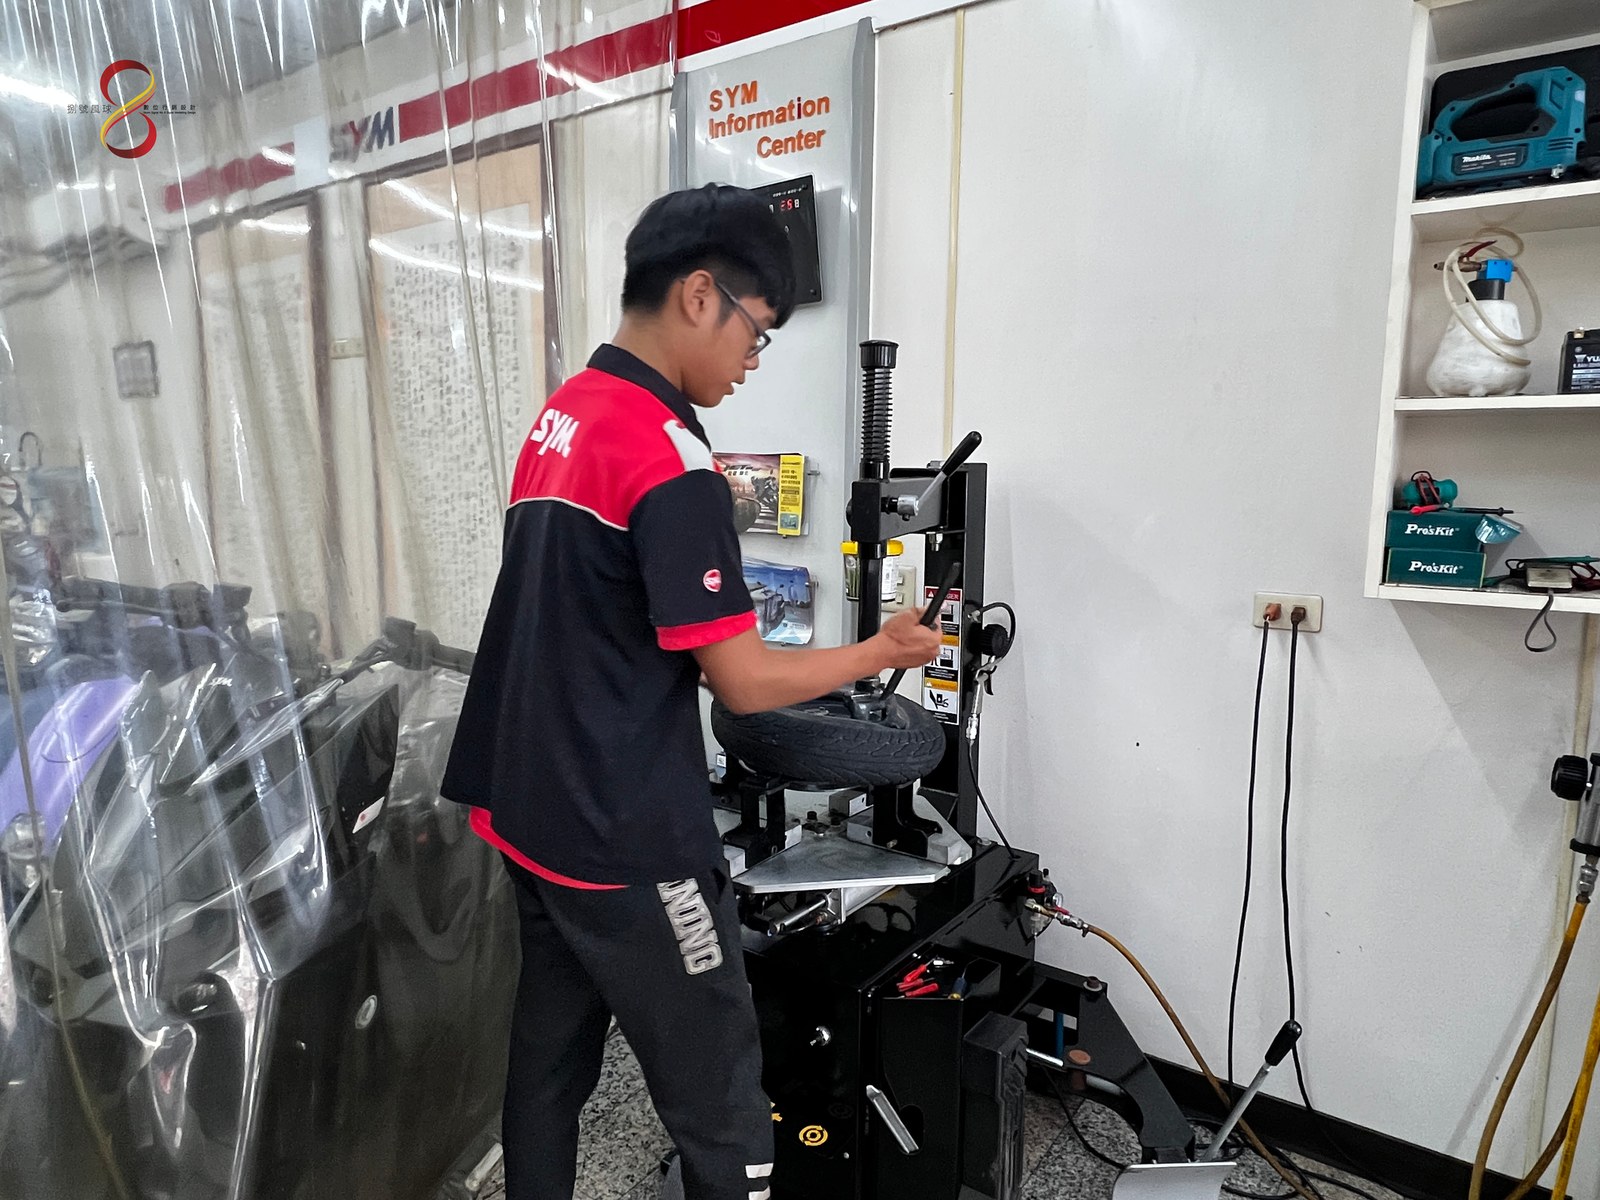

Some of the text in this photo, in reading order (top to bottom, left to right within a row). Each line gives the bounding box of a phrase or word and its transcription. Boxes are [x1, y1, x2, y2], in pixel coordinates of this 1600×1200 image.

[708, 96, 831, 139] Information
[709, 80, 758, 112] SYM
[756, 129, 826, 159] Center
[530, 408, 580, 458] SYM
[656, 877, 724, 976] NING
